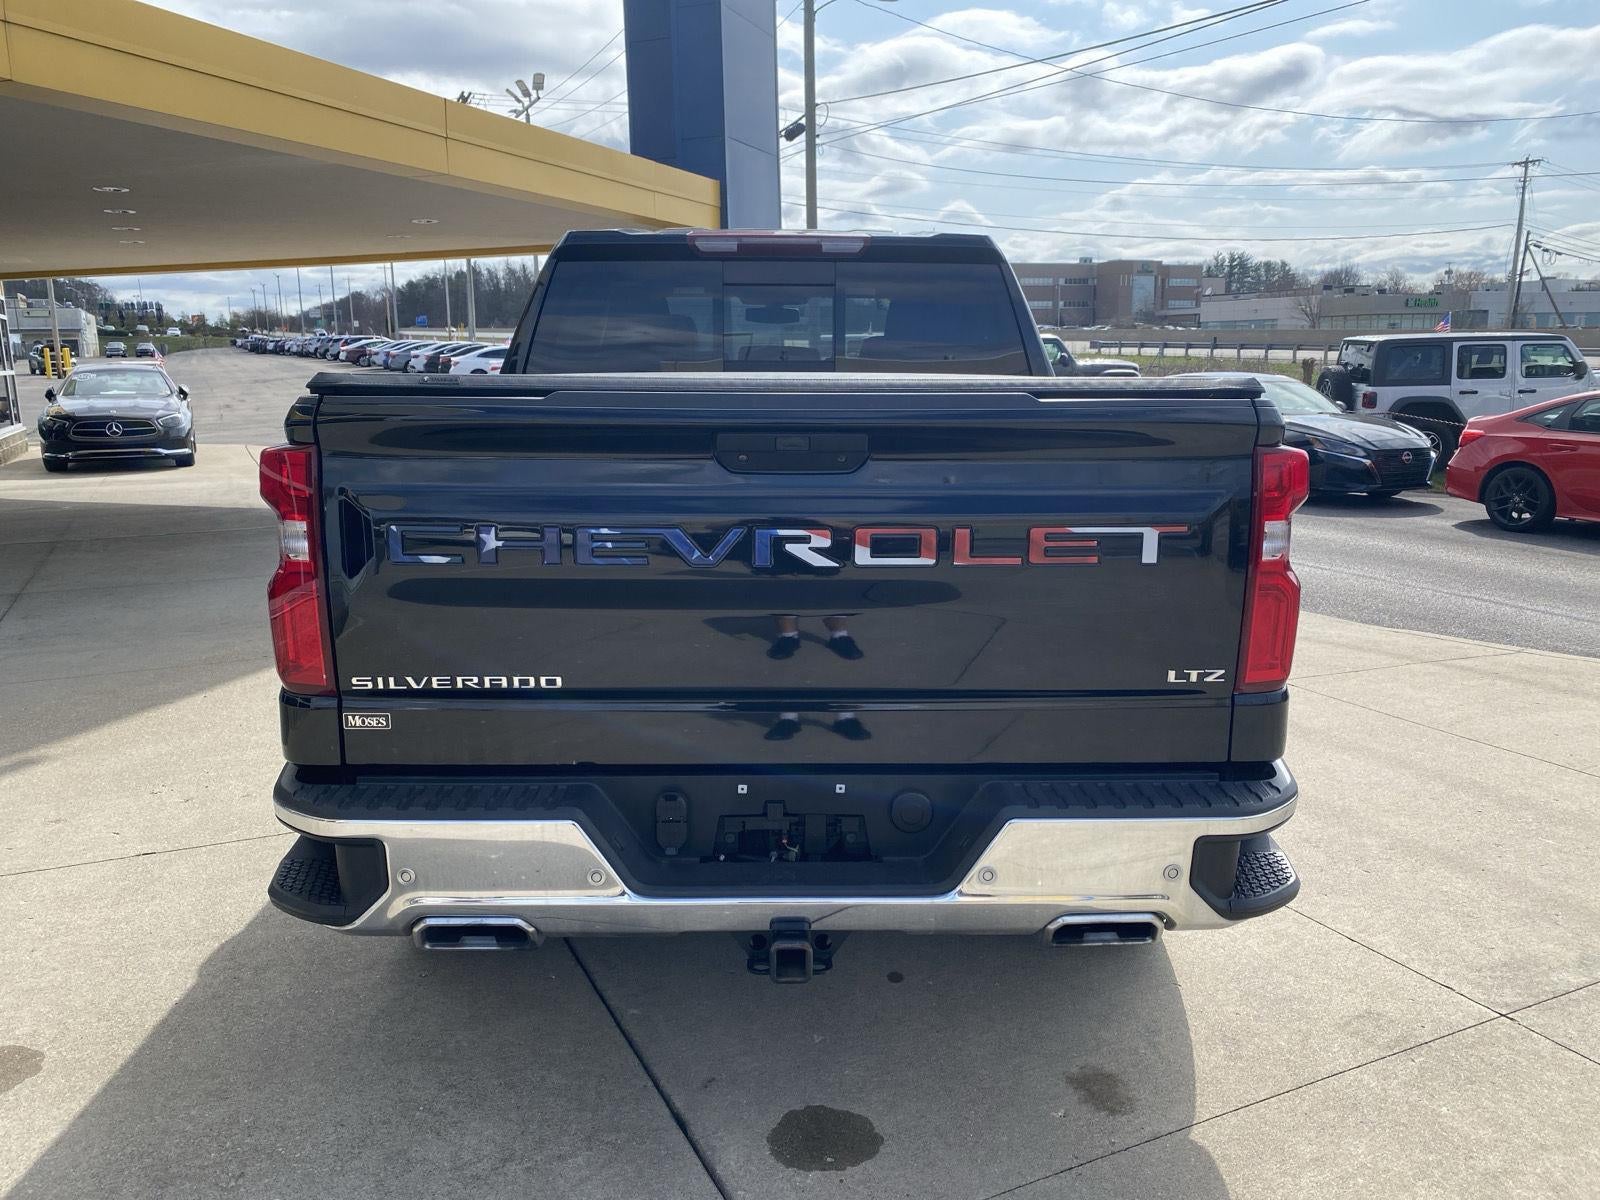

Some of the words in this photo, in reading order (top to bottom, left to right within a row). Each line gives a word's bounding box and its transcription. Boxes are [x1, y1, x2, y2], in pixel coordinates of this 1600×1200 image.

[386, 525, 1189, 567] CHEVROLET
[351, 676, 562, 690] SILVERADO
[1167, 669, 1226, 683] LTZ
[347, 715, 387, 728] MOSES
